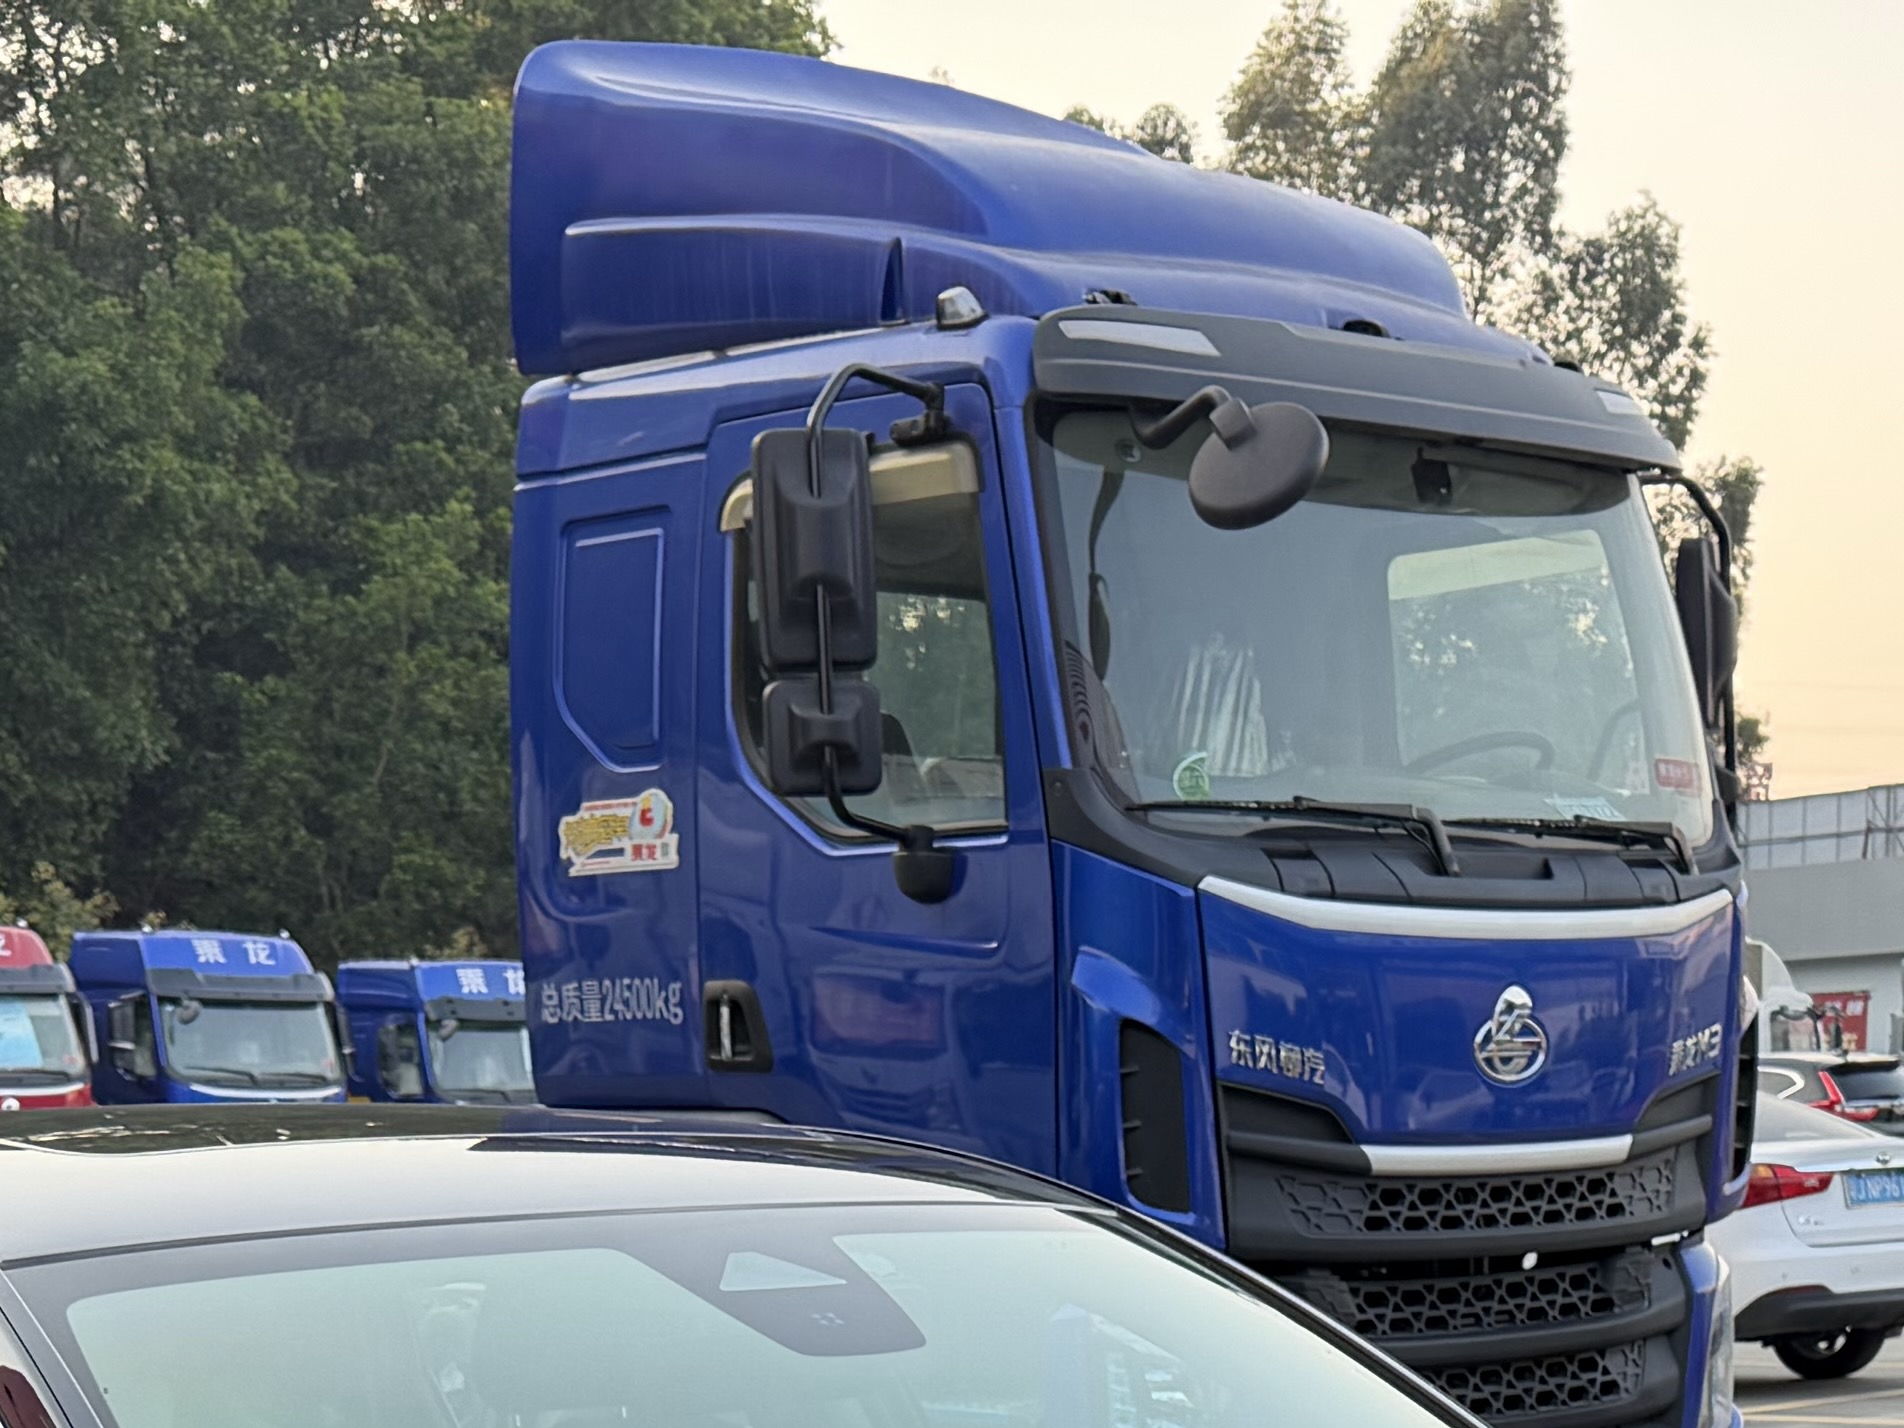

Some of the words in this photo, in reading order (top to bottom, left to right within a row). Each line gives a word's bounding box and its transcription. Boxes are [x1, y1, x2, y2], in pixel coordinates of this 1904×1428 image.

[191, 939, 276, 965] 乘龙
[541, 977, 683, 1025] 总质量24500kg
[1228, 1030, 1326, 1085] 东风柳汽
